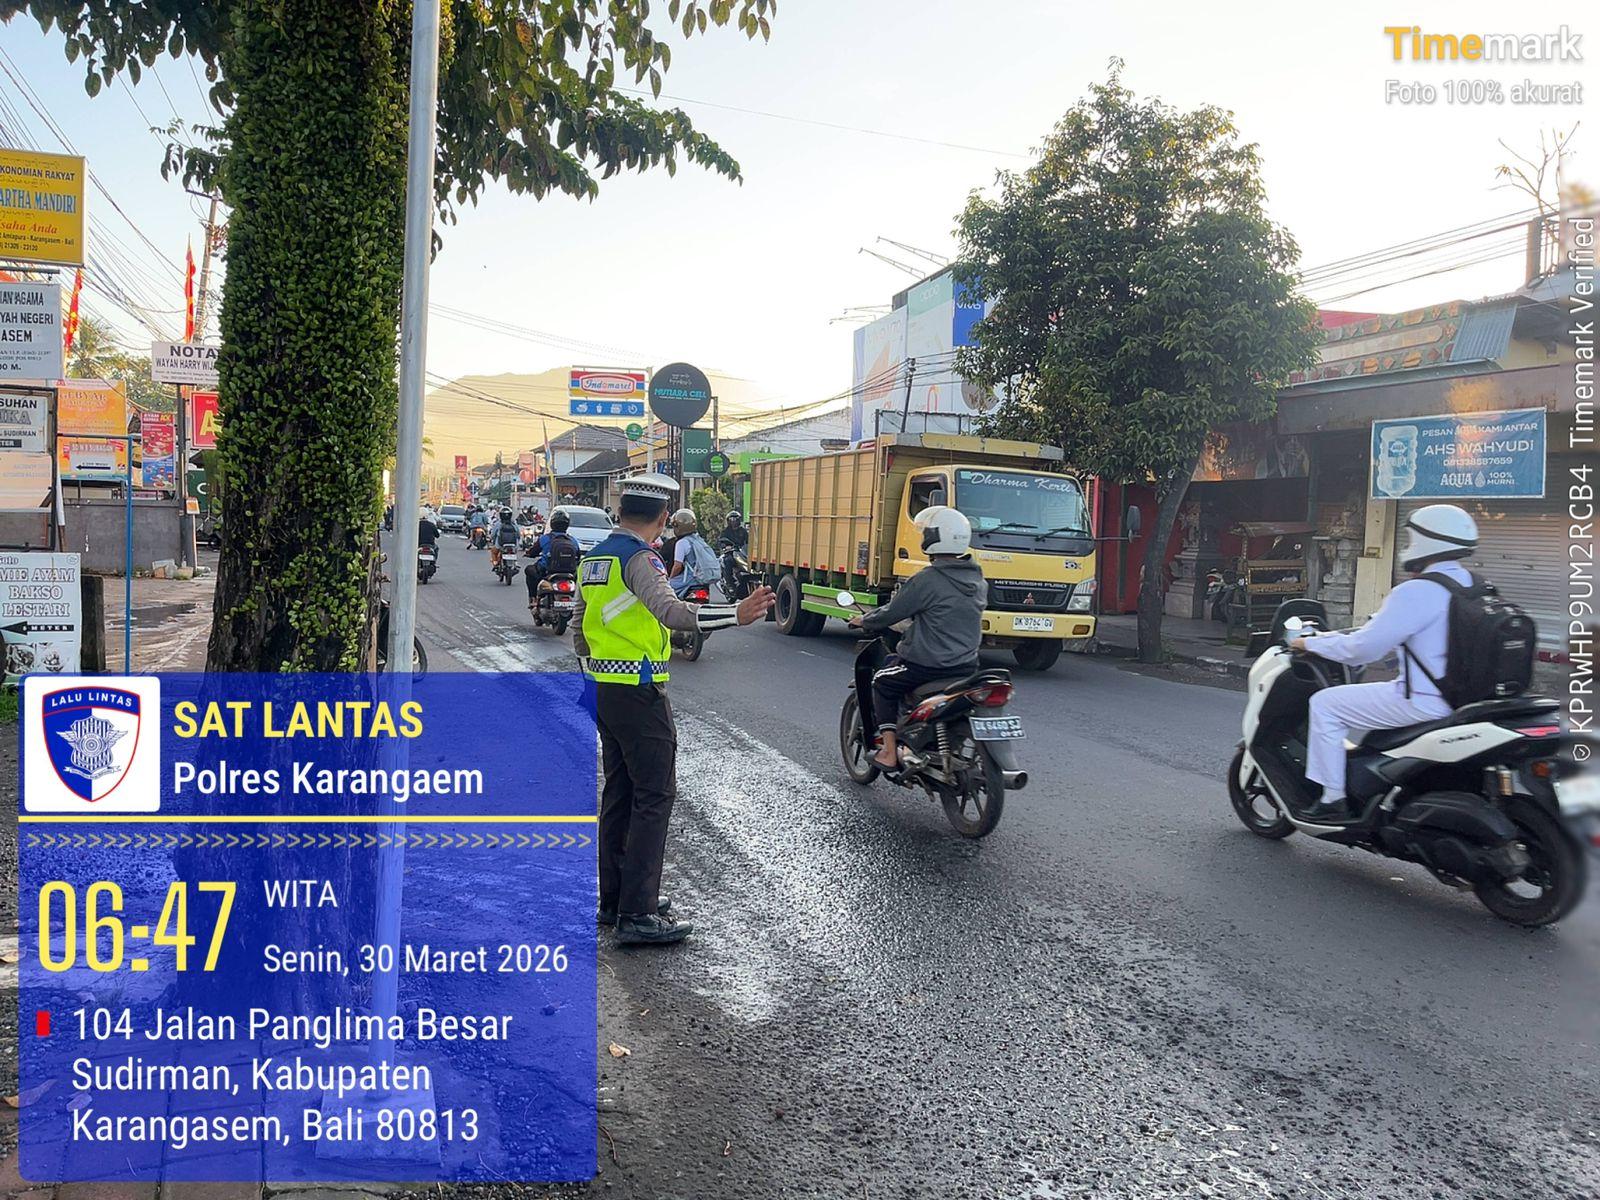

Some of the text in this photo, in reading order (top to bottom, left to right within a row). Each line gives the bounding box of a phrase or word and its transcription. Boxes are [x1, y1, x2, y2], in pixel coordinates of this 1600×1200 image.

[45, 170, 75, 181] RAKYAT
[34, 191, 76, 214] MANDIRI
[30, 222, 58, 234] Anda
[15, 291, 44, 306] AGAMA
[20, 312, 53, 325] NEGERI
[1, 329, 32, 342] ASEM
[155, 358, 178, 369] WAYAN
[180, 360, 200, 370] HARRY
[584, 379, 632, 390] Indomaret
[1422, 428, 1454, 437] PESAN
[1504, 422, 1538, 432] ANTAR
[1424, 443, 1455, 455] AHS
[1440, 473, 1473, 487] AQUA
[32, 568, 75, 582] AYAM
[9, 585, 63, 600] BAKSO
[3, 603, 70, 617] LESTARI
